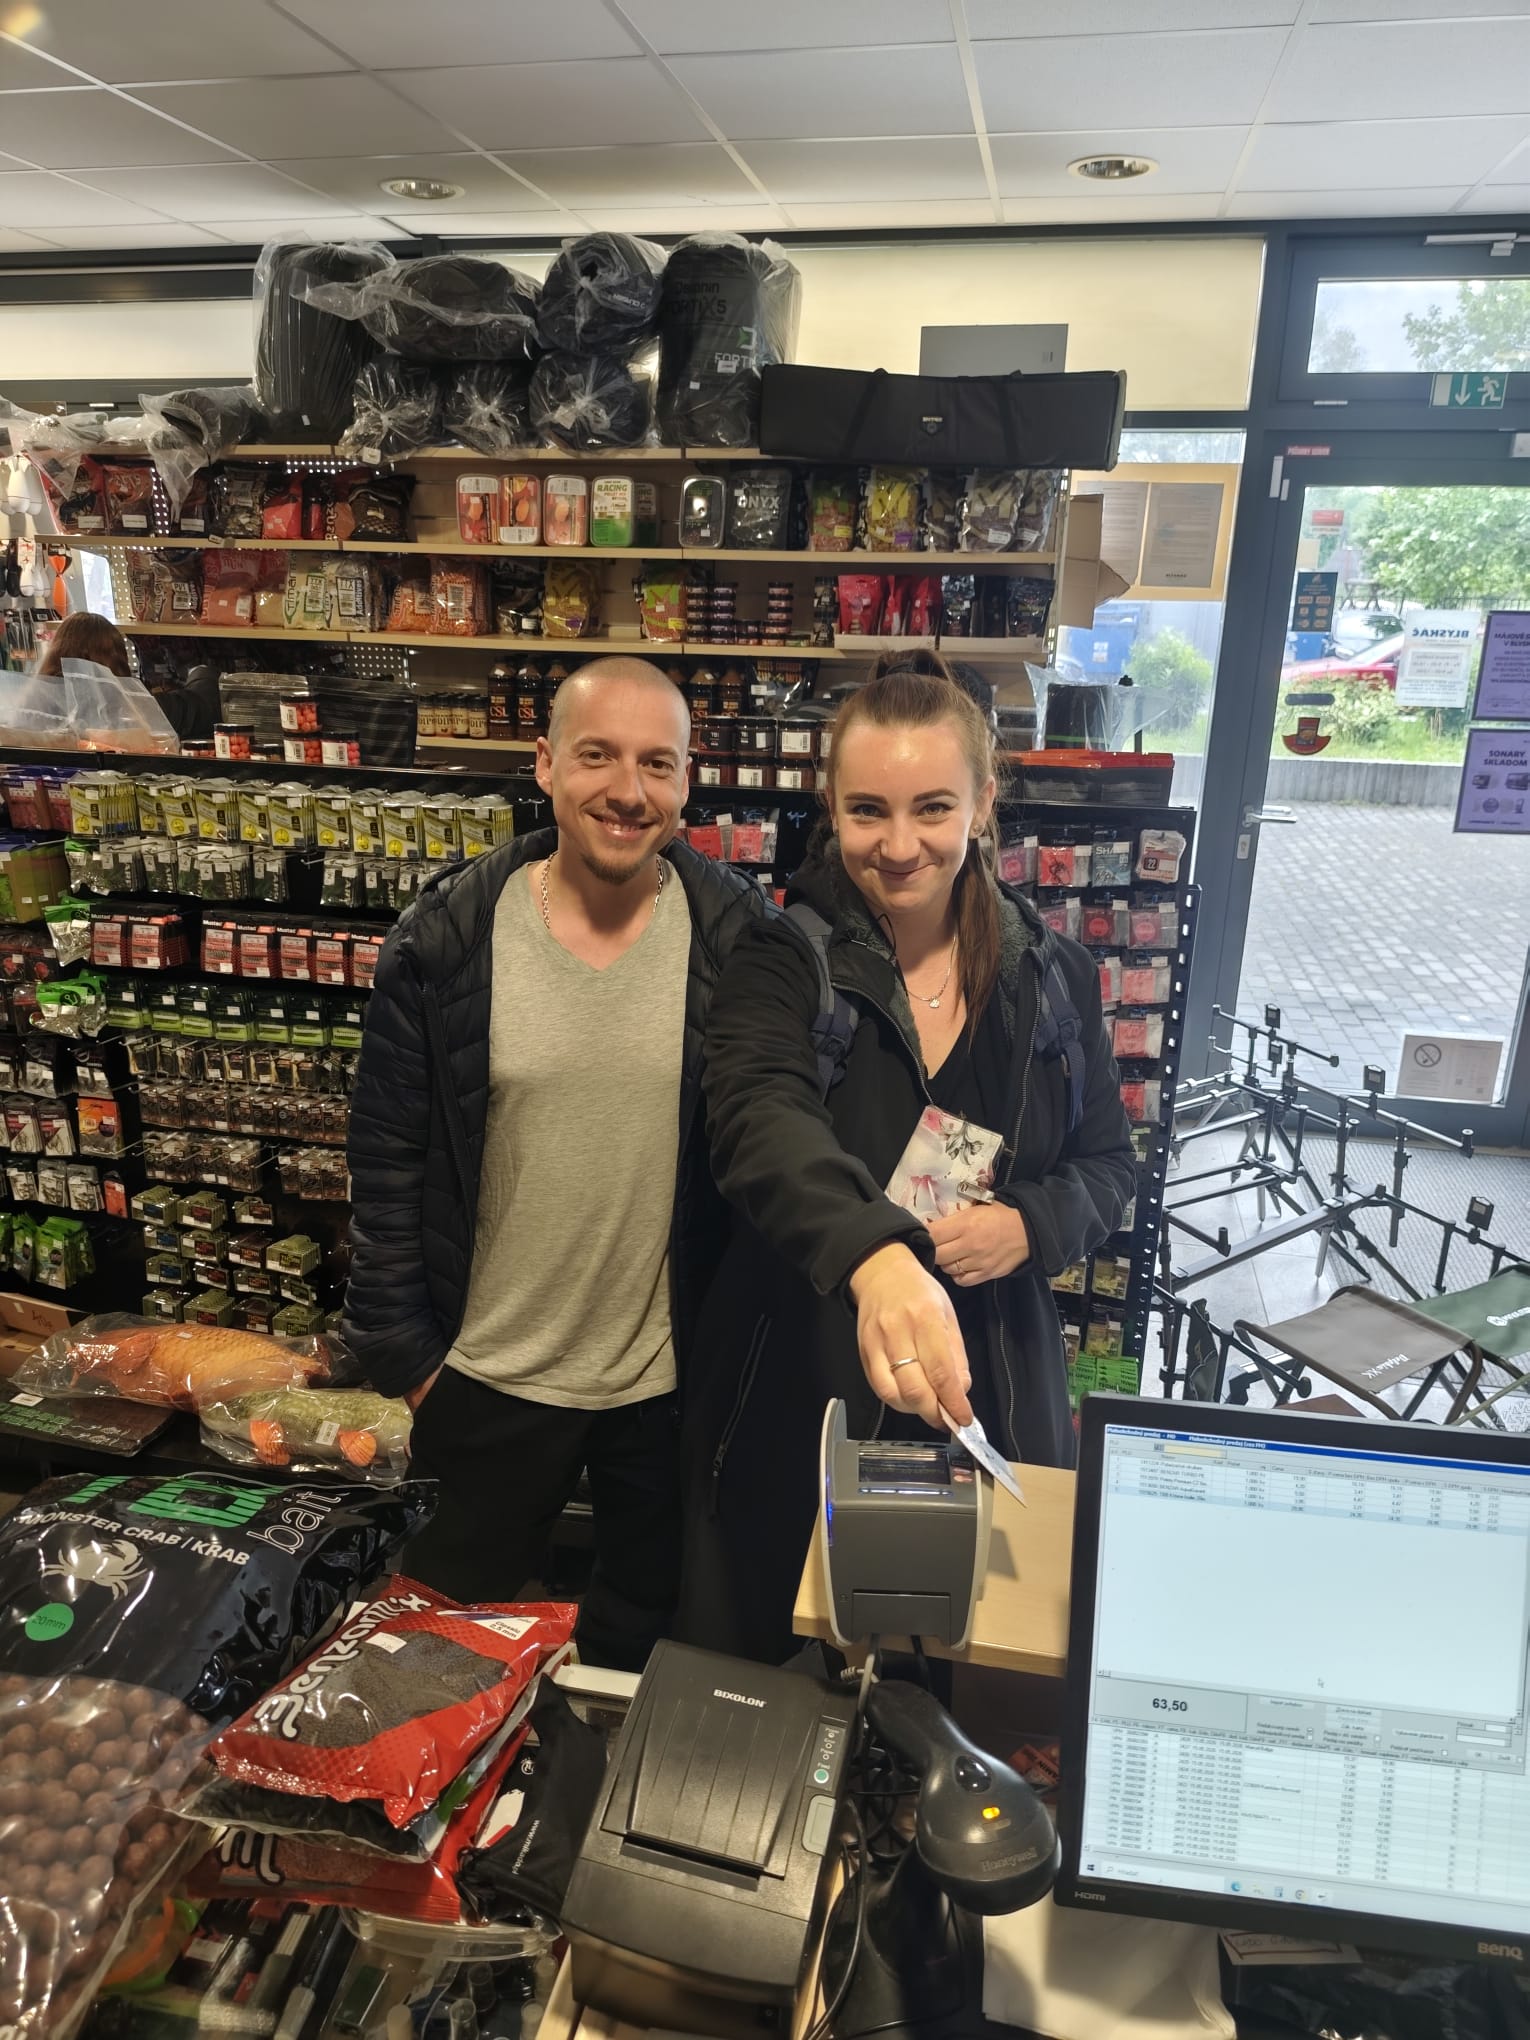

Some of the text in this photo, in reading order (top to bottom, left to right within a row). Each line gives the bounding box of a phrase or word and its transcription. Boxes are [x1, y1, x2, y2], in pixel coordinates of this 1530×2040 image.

[596, 484, 628, 492] RACING
[490, 706, 509, 717] CSL
[518, 707, 537, 719] CSL
[1488, 750, 1526, 758] SONARY
[1483, 758, 1528, 767] SKLADOM
[20, 1510, 122, 1533] MONSTER
[123, 1526, 181, 1547] CRAB
[190, 1540, 250, 1566] KRAB
[713, 1688, 765, 1708] BIXOLON
[1152, 1698, 1188, 1712] 63,50
[1477, 1941, 1524, 1961] BenQ
